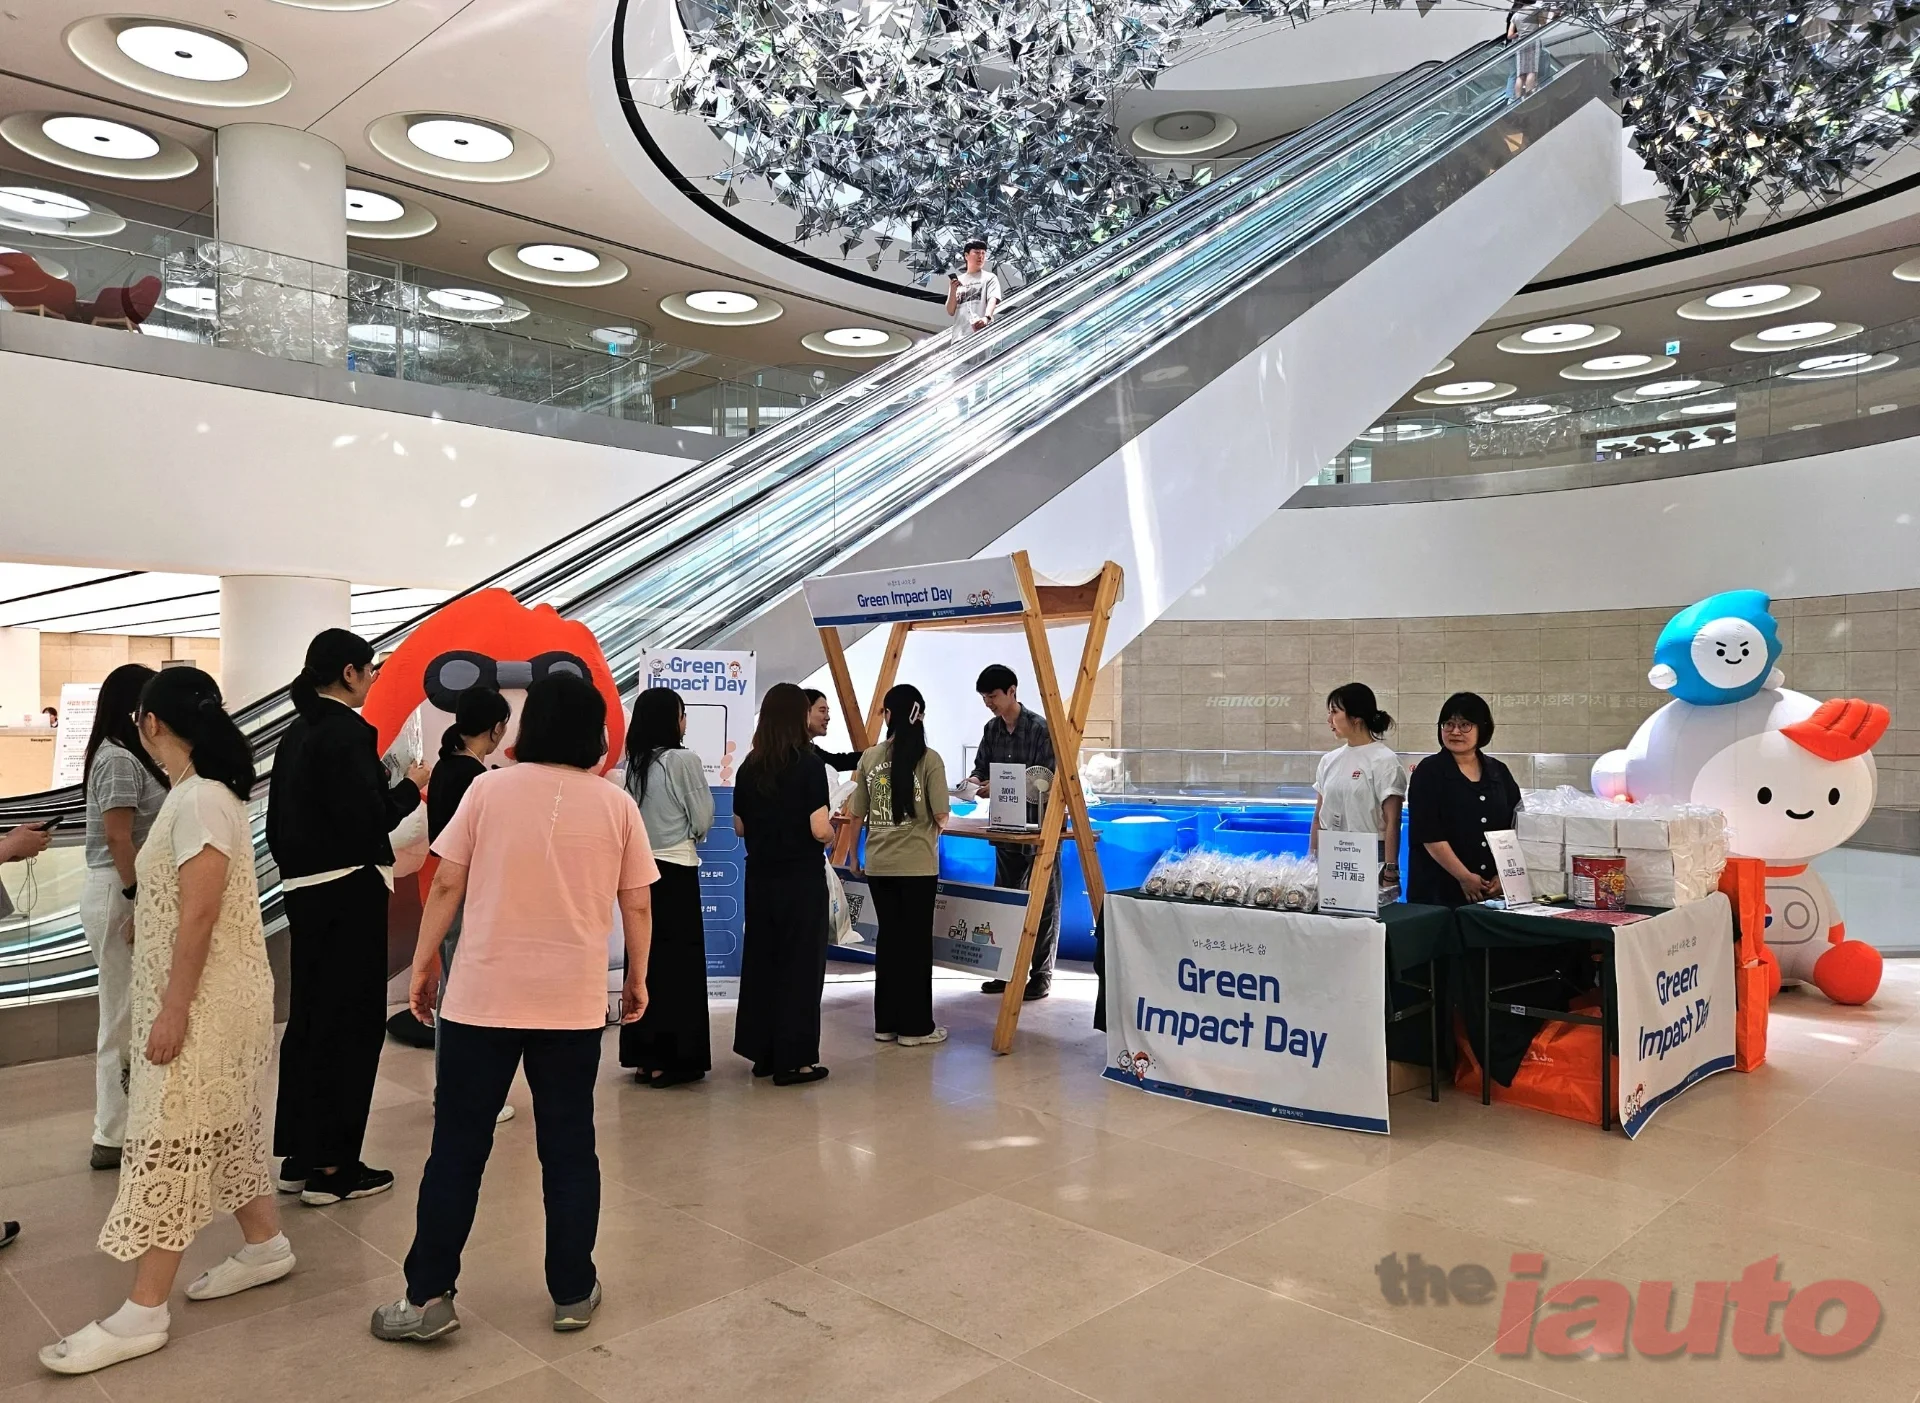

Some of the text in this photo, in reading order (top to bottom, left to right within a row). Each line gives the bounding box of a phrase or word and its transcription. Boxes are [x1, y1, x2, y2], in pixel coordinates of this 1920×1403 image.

[857, 586, 953, 608] Green Impact Day
[671, 656, 725, 674] Green
[647, 674, 747, 695] Impact Day
[1533, 694, 1575, 708] 사회적
[1332, 870, 1365, 882] 쿠키 제공
[1335, 862, 1359, 872] 리워드
[1229, 943, 1255, 954] 나누는
[1257, 944, 1267, 955] 삶
[1178, 957, 1280, 1003] Green
[1656, 963, 1698, 1006] Green
[1136, 996, 1328, 1069] Impact Day
[1639, 1005, 1693, 1062] Impact
